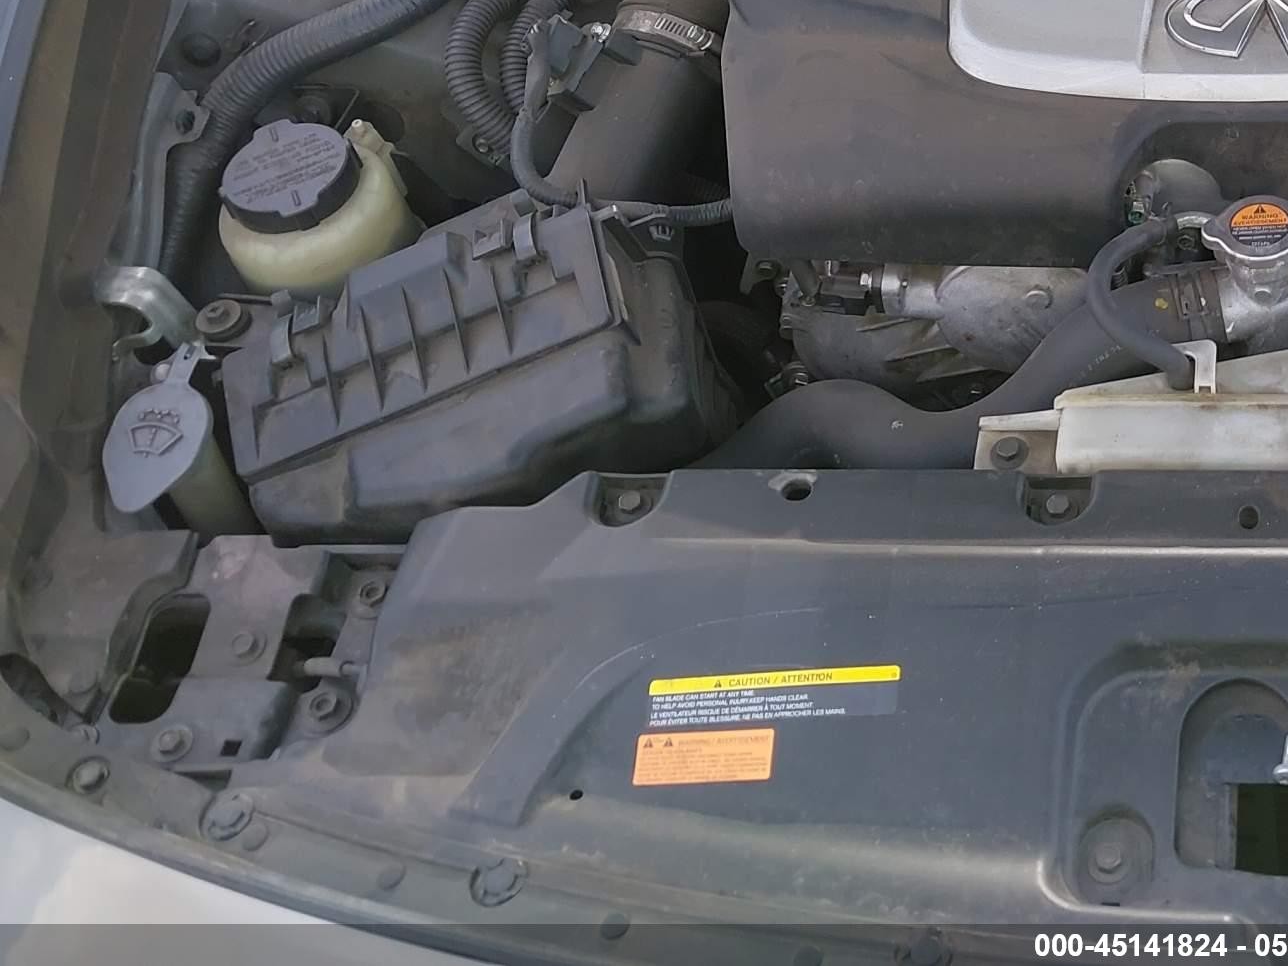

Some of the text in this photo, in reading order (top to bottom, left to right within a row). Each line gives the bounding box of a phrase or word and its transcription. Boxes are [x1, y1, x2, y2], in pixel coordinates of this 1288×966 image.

[728, 678, 769, 686] CAUTION
[781, 672, 832, 683] ATTENTION
[696, 699, 727, 707] PERSONAL
